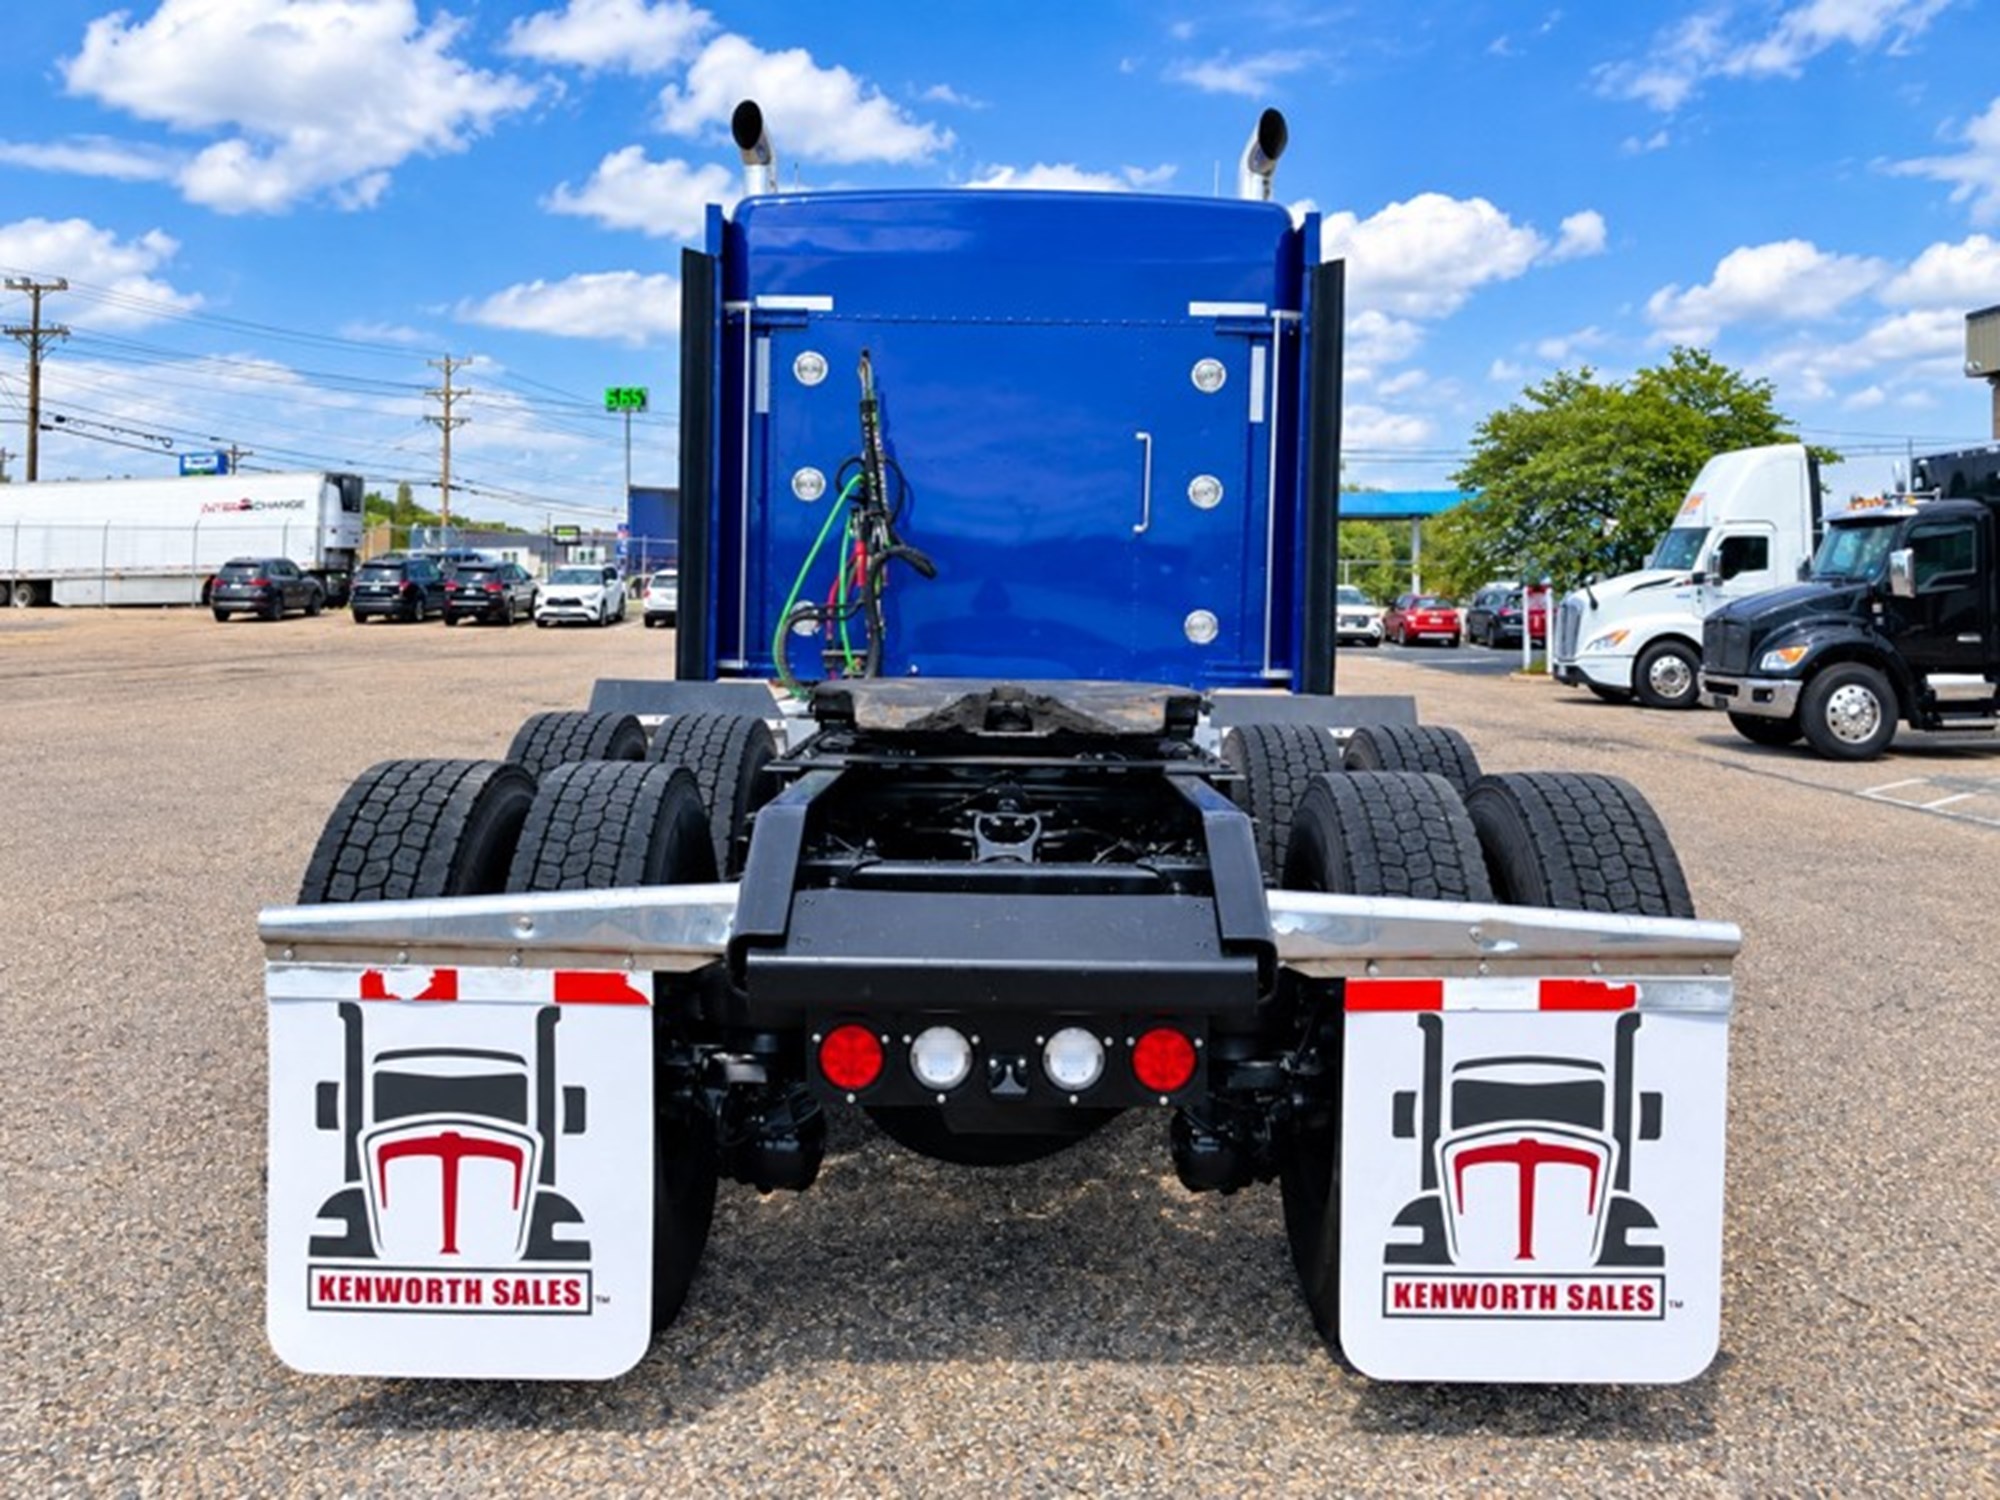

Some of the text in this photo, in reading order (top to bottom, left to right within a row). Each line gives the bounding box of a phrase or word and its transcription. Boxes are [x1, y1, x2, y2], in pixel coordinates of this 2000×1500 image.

[319, 1275, 482, 1305] KENWORTH
[492, 1278, 581, 1306] SALES
[1394, 1282, 1557, 1310] KENWORTH
[1566, 1284, 1655, 1311] SALES
